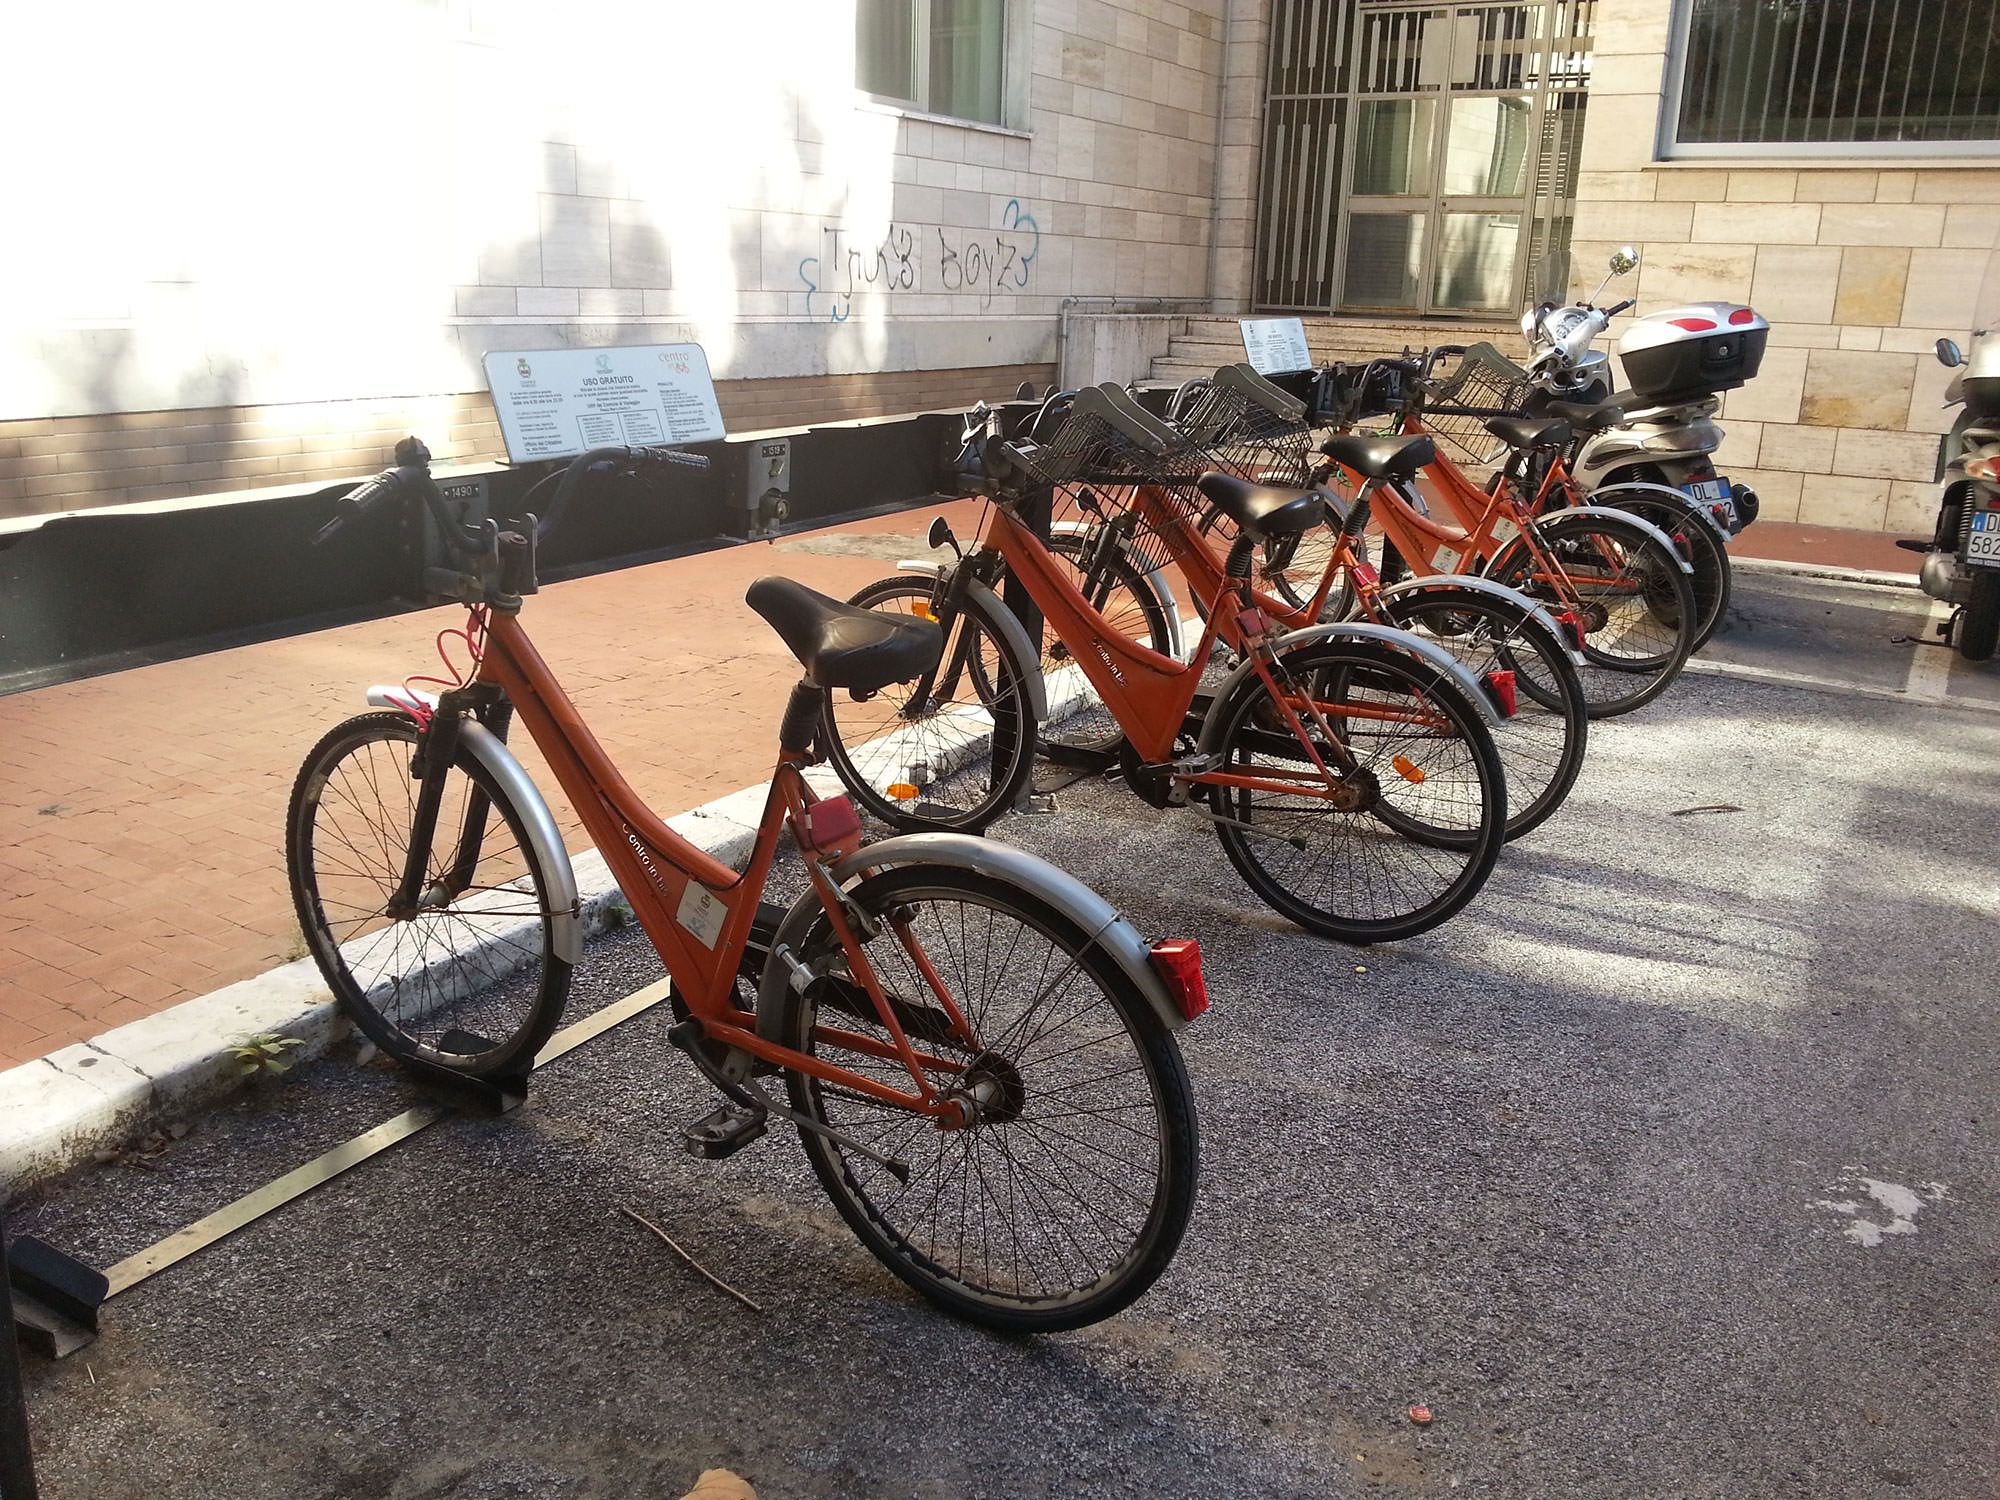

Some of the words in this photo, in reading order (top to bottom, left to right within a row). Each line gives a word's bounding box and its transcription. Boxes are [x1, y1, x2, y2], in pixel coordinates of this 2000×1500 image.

[582, 378, 598, 386] USO
[599, 376, 634, 385] GRATUITO
[1692, 484, 1712, 501] DL
